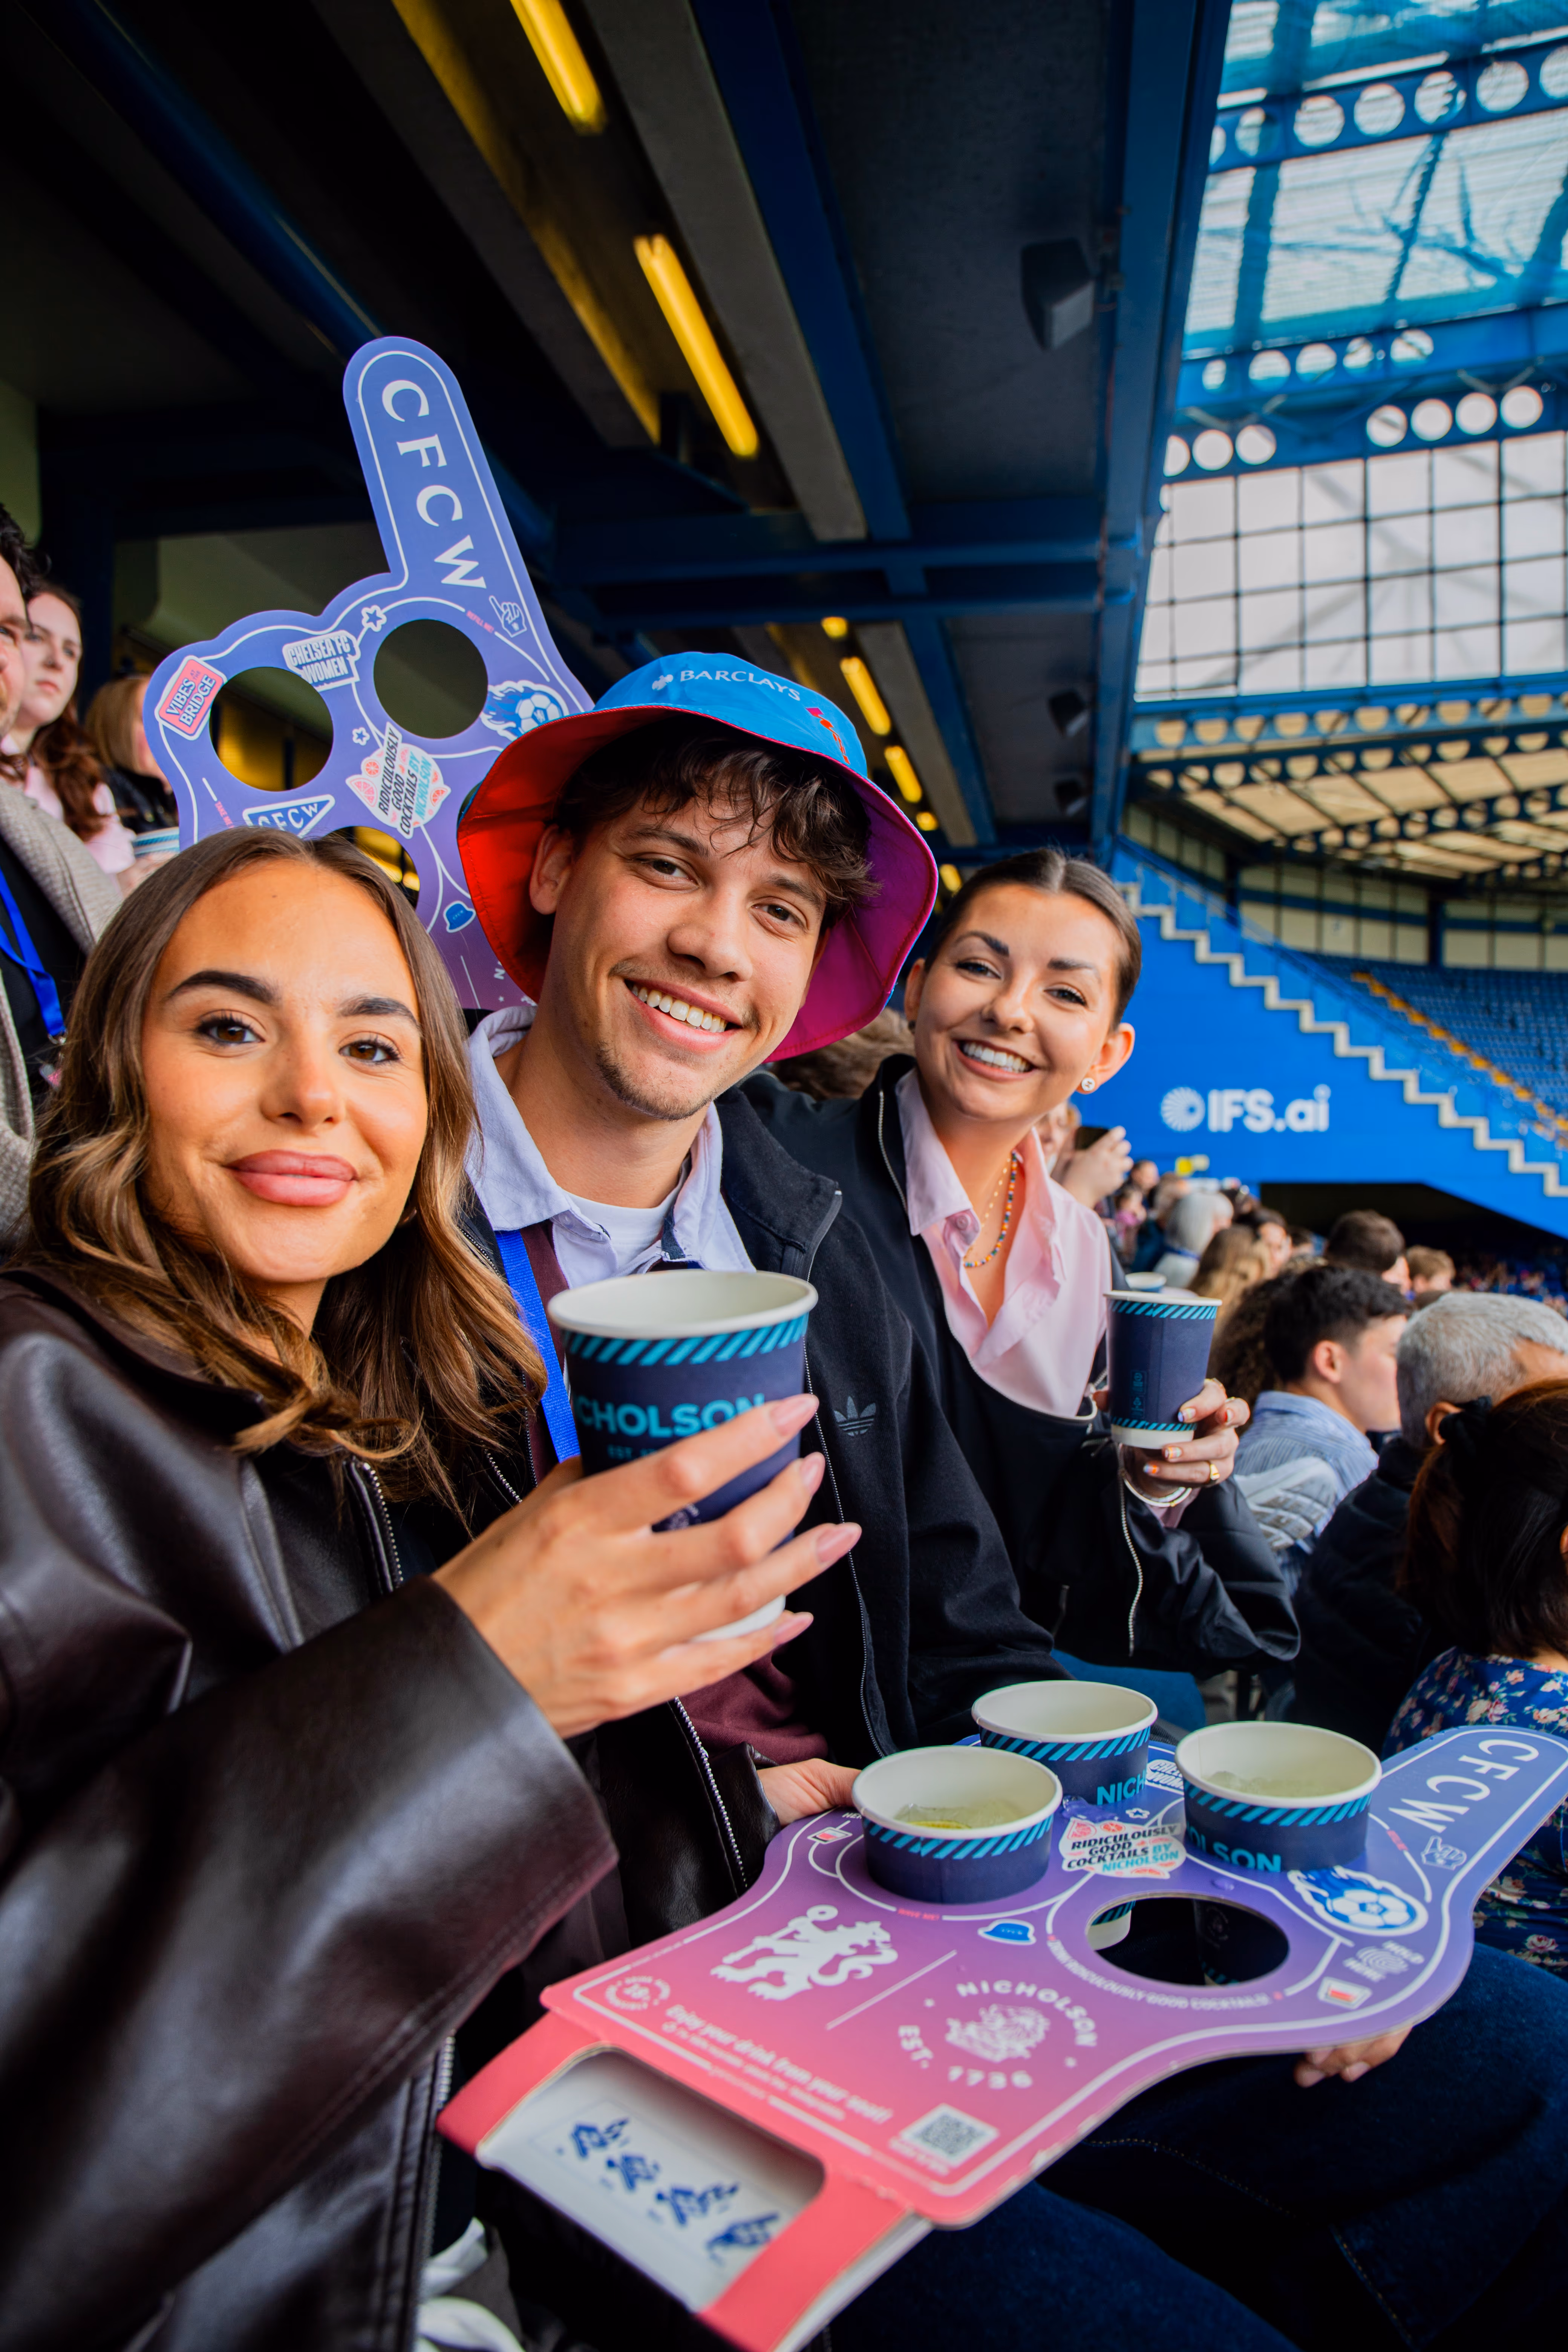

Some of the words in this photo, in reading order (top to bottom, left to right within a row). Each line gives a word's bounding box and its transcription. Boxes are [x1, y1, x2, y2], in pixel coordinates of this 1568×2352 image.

[382, 380, 487, 588] CFCW
[288, 638, 335, 667] CHELSEA
[335, 635, 351, 654] FC
[302, 657, 349, 684] WOMEN
[680, 670, 800, 701] BARCLAYS
[166, 677, 196, 716] VIBES
[179, 675, 216, 726] BRIDGE
[378, 727, 399, 816] RIDICULOUSLY
[415, 756, 432, 820] NICHOLSON
[214, 801, 228, 817] TAKE
[392, 773, 404, 811] GOOD
[400, 770, 418, 835] COCKTAILS
[409, 751, 420, 773] BY
[1207, 1083, 1332, 1133] IFS.ai
[1388, 1739, 1539, 1834] CFCW
[1067, 1847, 1149, 1869] COCKTAILS
[1152, 1842, 1173, 1854] BY
[1071, 1825, 1178, 1851] RIDICULOUSLY
[1088, 1841, 1132, 1857] GOOD
[1102, 1851, 1179, 1873] NICHOLSON
[956, 1980, 1098, 2047] NICHOLSON
